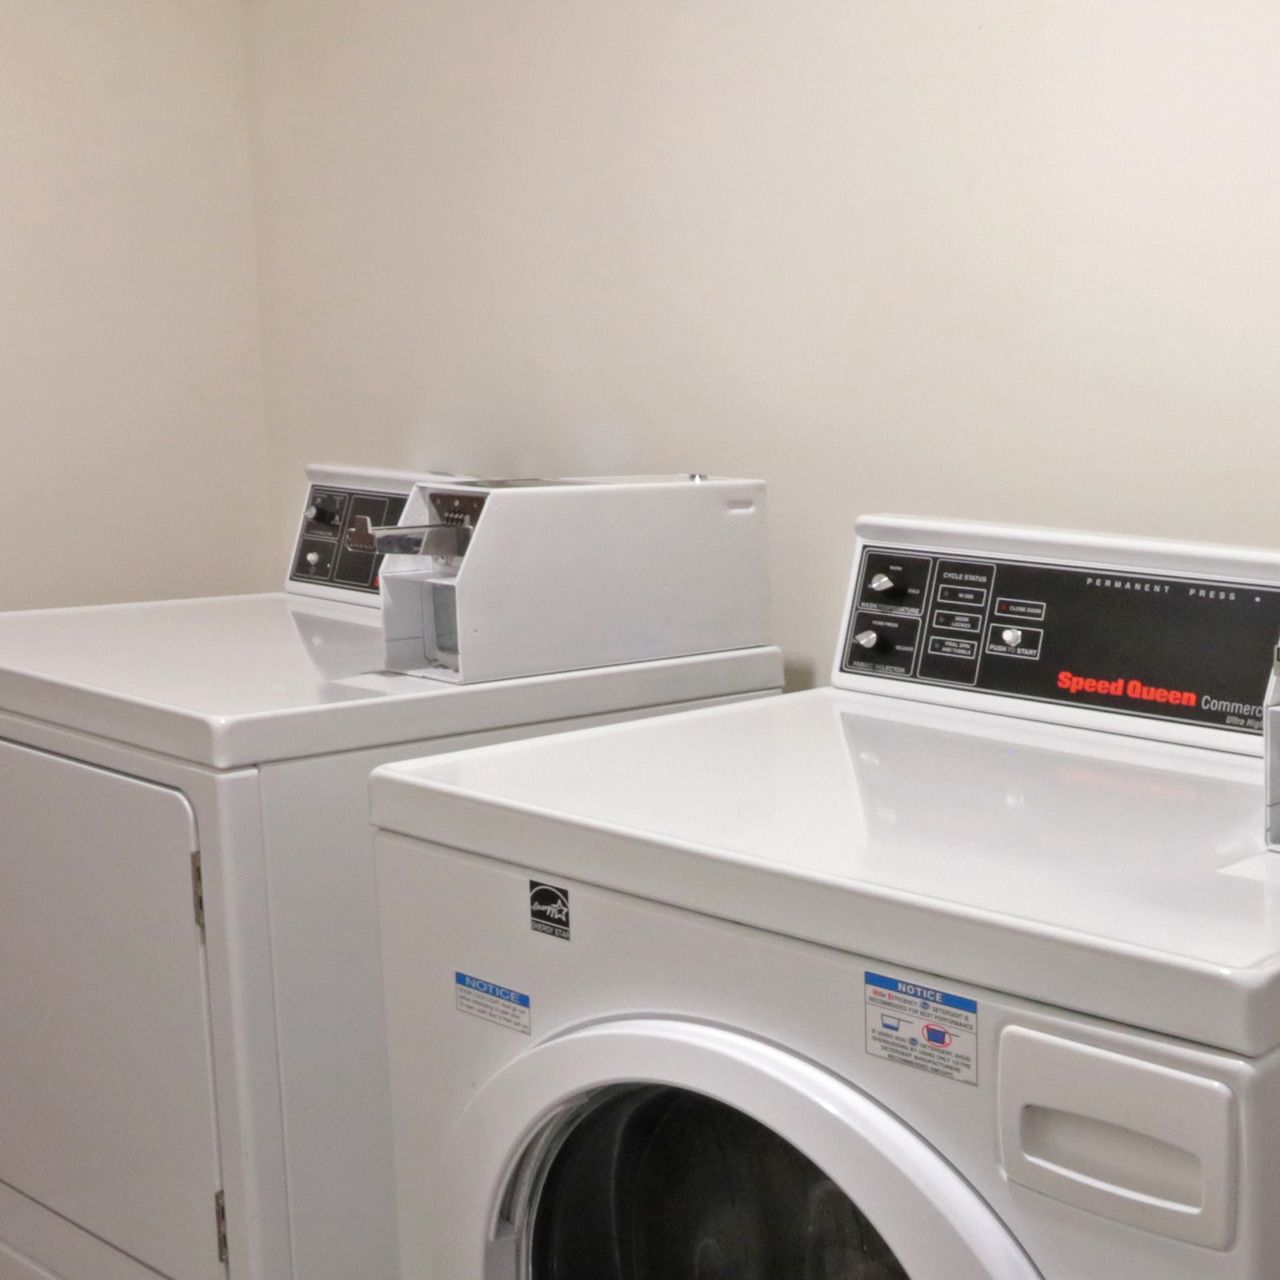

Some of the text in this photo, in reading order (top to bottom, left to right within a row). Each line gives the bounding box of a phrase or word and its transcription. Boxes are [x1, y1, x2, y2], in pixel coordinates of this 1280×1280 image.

[943, 572, 987, 582] CYCLE STATUS
[1086, 577, 1170, 594] PERMANENT
[1189, 588, 1236, 601] PRESS
[989, 643, 1007, 652] PUSH
[1017, 648, 1037, 657] START
[1057, 671, 1124, 694] Speed
[1126, 679, 1198, 708] Queen
[465, 975, 520, 1003] NOTICE
[897, 982, 943, 1003] NOTICE
